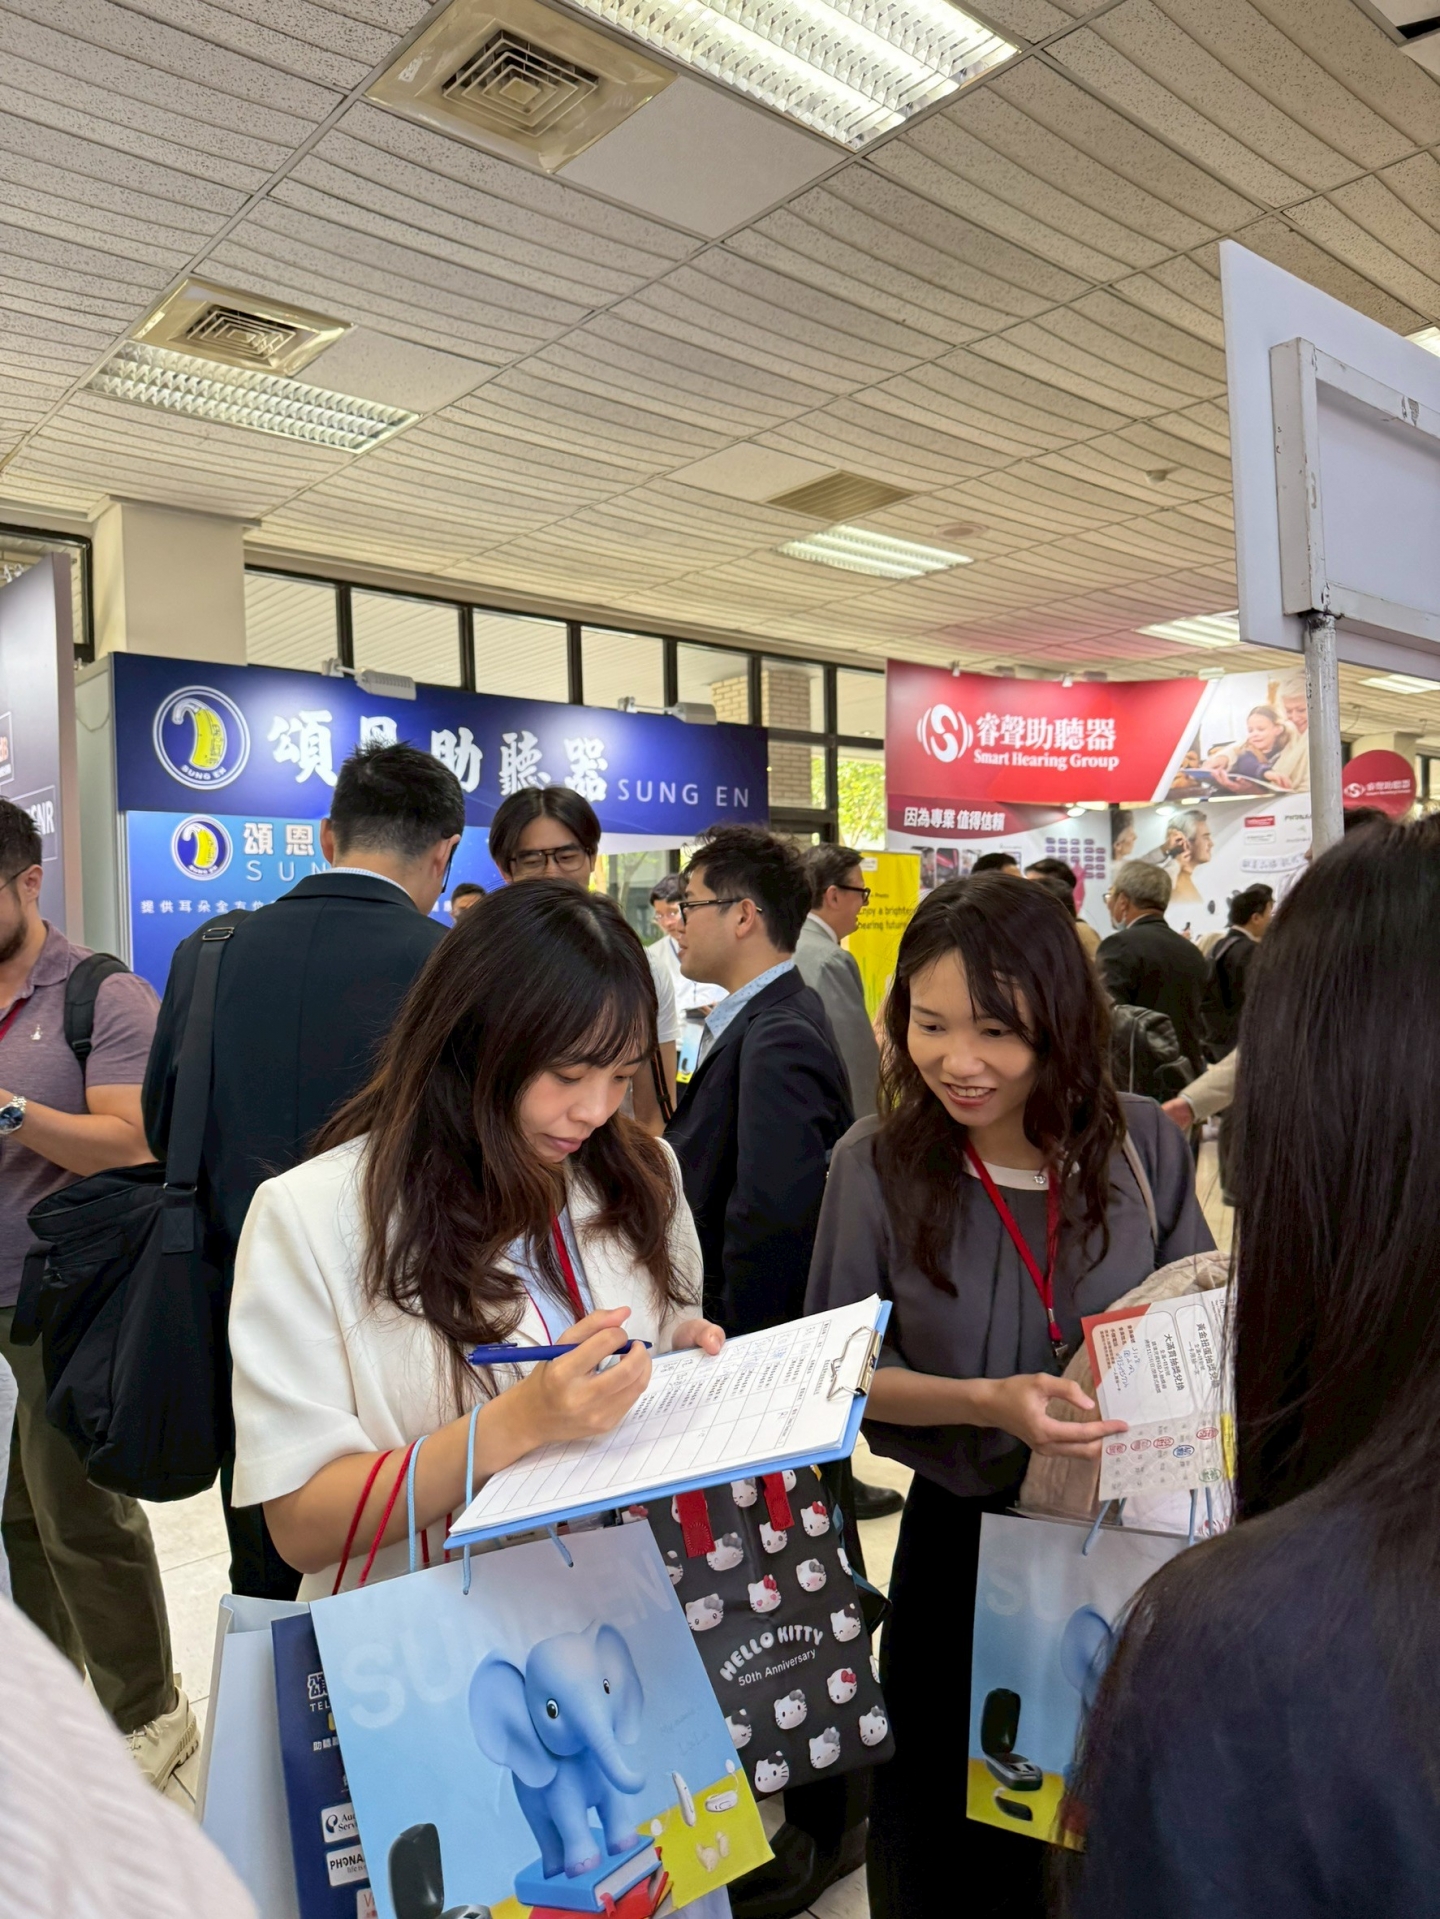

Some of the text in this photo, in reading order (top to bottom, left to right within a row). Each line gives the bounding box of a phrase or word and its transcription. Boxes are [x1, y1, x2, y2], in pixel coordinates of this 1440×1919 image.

[976, 712, 1116, 751] 睿聲助聽器
[974, 748, 1120, 772] Smart Hearing Group
[617, 778, 749, 808] SUNG EN
[904, 806, 1006, 831] 因為專業 值得信賴
[243, 822, 315, 856] 頌恩
[719, 1624, 824, 1681] HELLO KITTY
[738, 1649, 816, 1687] 50th Anniversary
